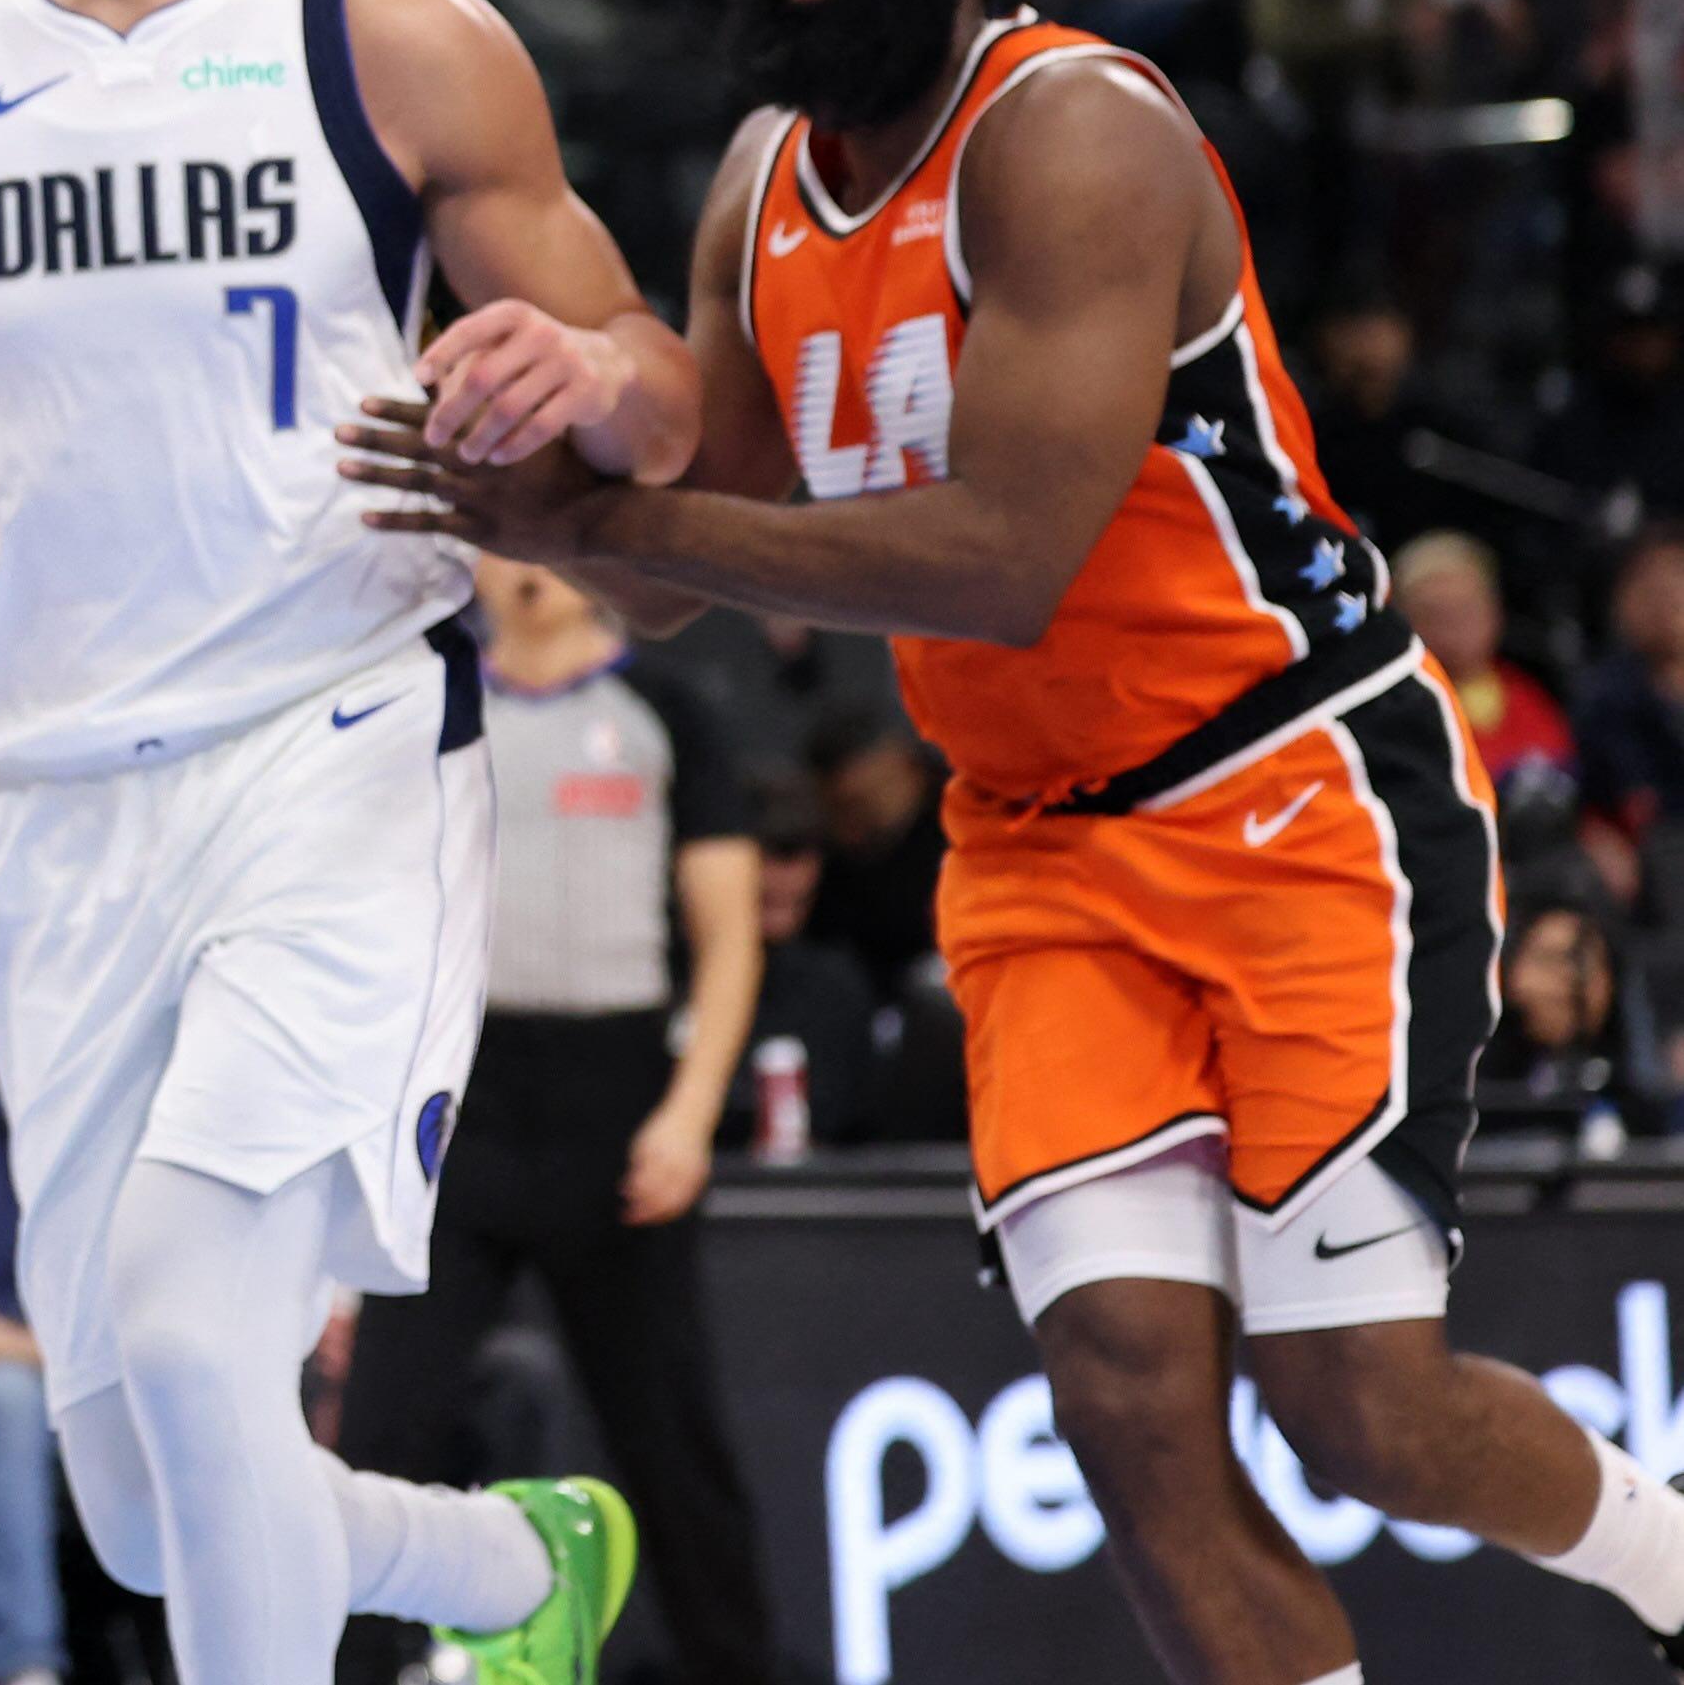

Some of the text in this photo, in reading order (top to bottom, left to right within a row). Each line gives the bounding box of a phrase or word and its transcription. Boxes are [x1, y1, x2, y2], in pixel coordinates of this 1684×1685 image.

[180, 56, 285, 92] chime
[223, 284, 299, 433] 7
[791, 313, 955, 500] LA
